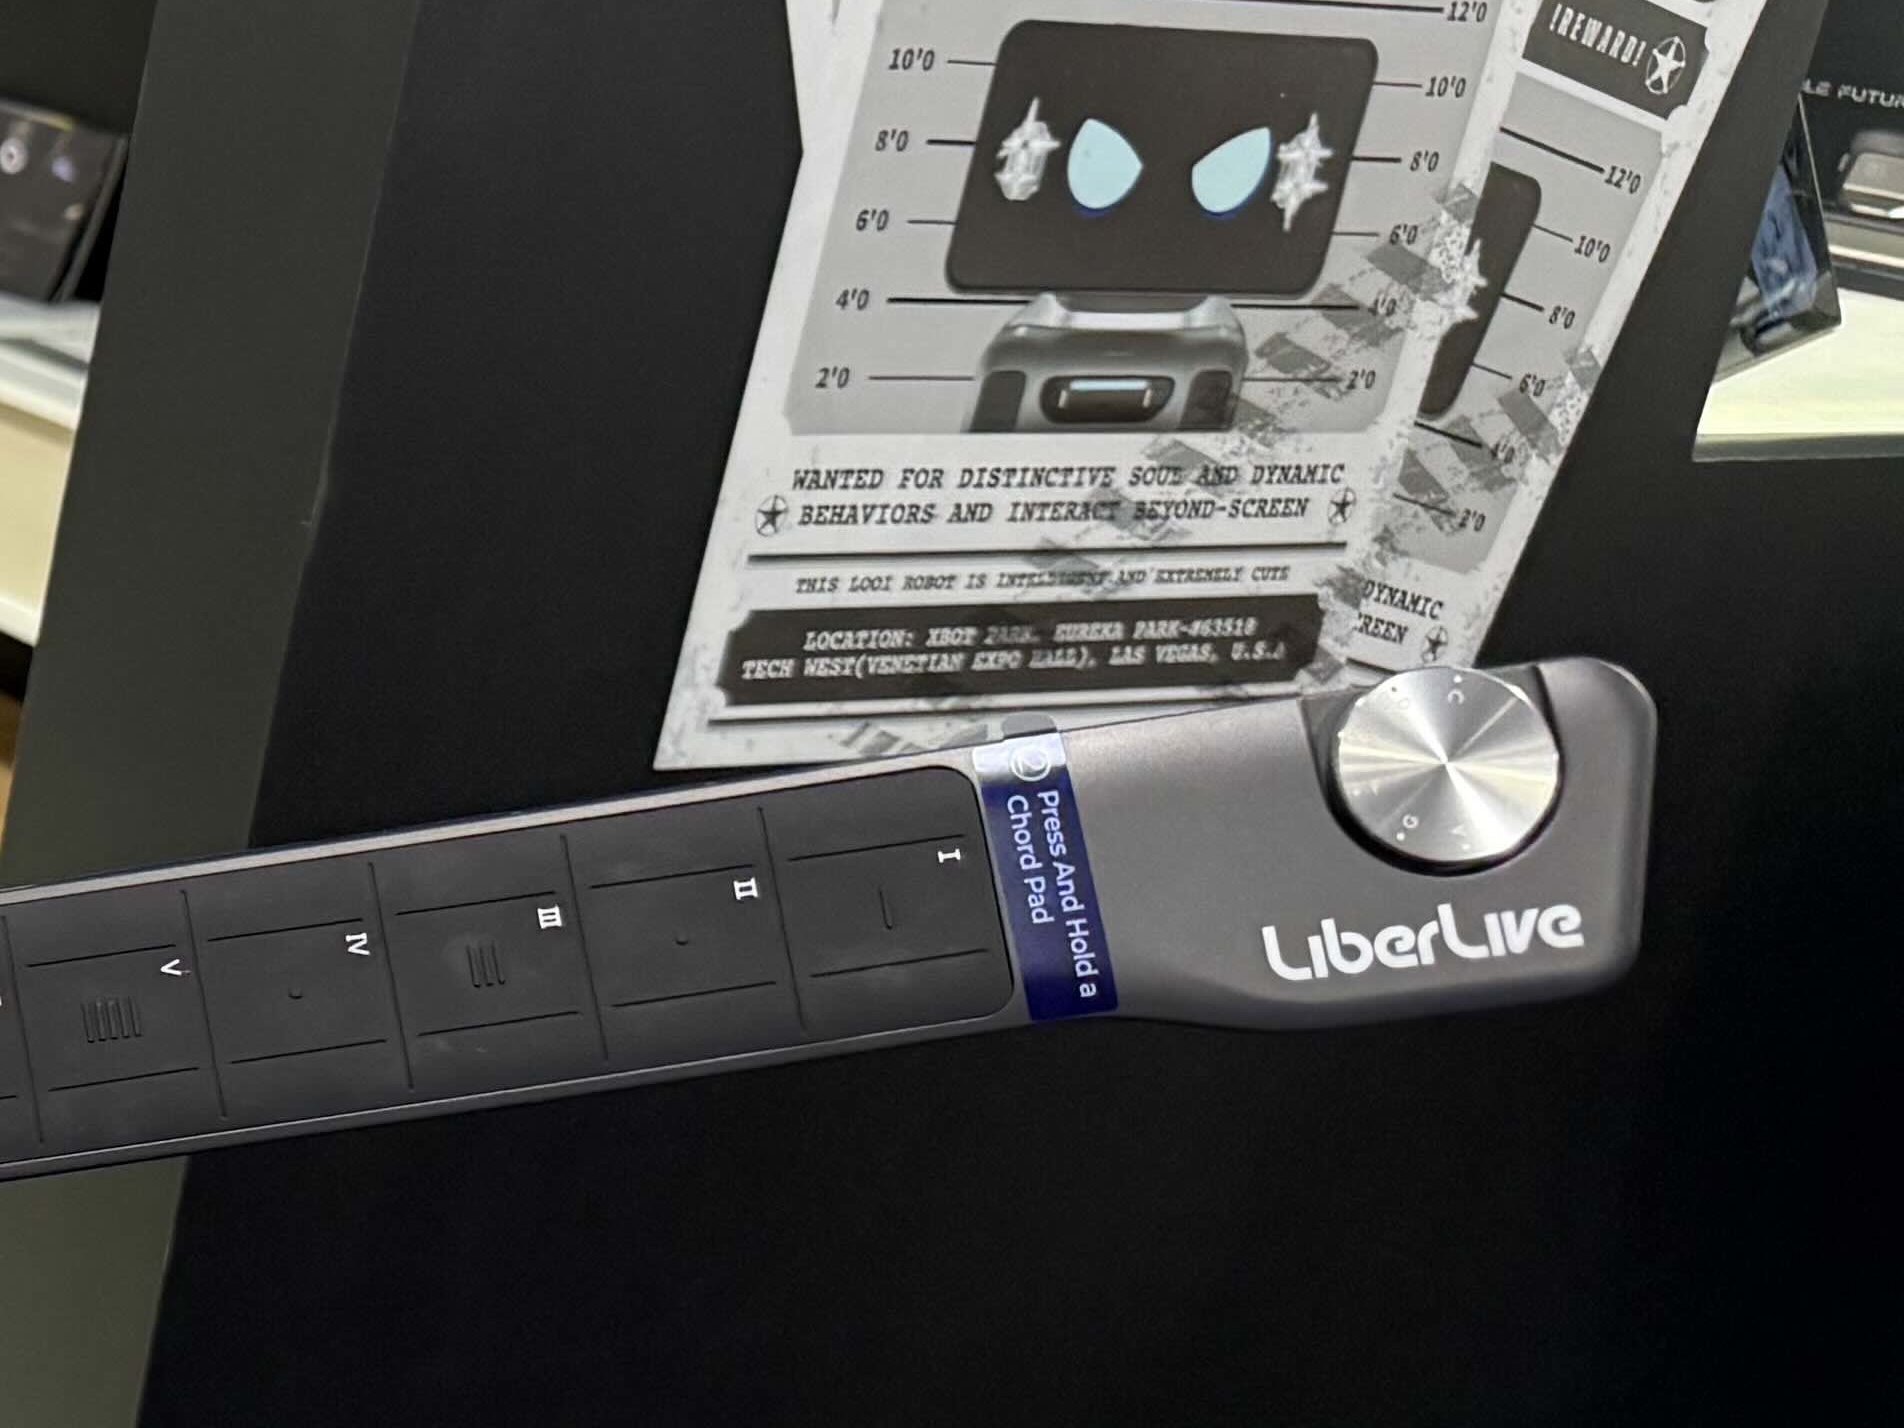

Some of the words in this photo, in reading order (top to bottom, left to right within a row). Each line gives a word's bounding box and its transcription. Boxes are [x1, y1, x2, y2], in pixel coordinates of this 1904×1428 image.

[1550, 3, 1646, 66] !REWARD!
[889, 48, 936, 71] 10'0
[875, 130, 909, 152] 8'0
[856, 209, 889, 232] 6'0
[836, 288, 870, 310] 4'0
[815, 367, 851, 389] 2'0
[792, 467, 885, 490] WANTED
[898, 468, 944, 489] FOR
[957, 466, 1116, 489] DISTINCTIVE
[1196, 464, 1238, 486] AND
[1250, 463, 1344, 484] DYNAMIC
[797, 503, 937, 526] BEHAVIORS
[946, 502, 994, 524] AND
[1008, 500, 1121, 522] INTERACT
[1133, 497, 1310, 520] BEYOND-SCREEN
[803, 628, 915, 651] LOCATION:
[1353, 612, 1408, 644] REEN
[742, 658, 795, 680] TECH
[1007, 794, 1043, 871] Chord
[1037, 789, 1067, 857] Press
[1023, 875, 1056, 925] Pad
[1053, 861, 1085, 913] And
[1065, 917, 1099, 978] Hold
[1262, 902, 1584, 980] LiberLive
[1079, 982, 1098, 998] a
